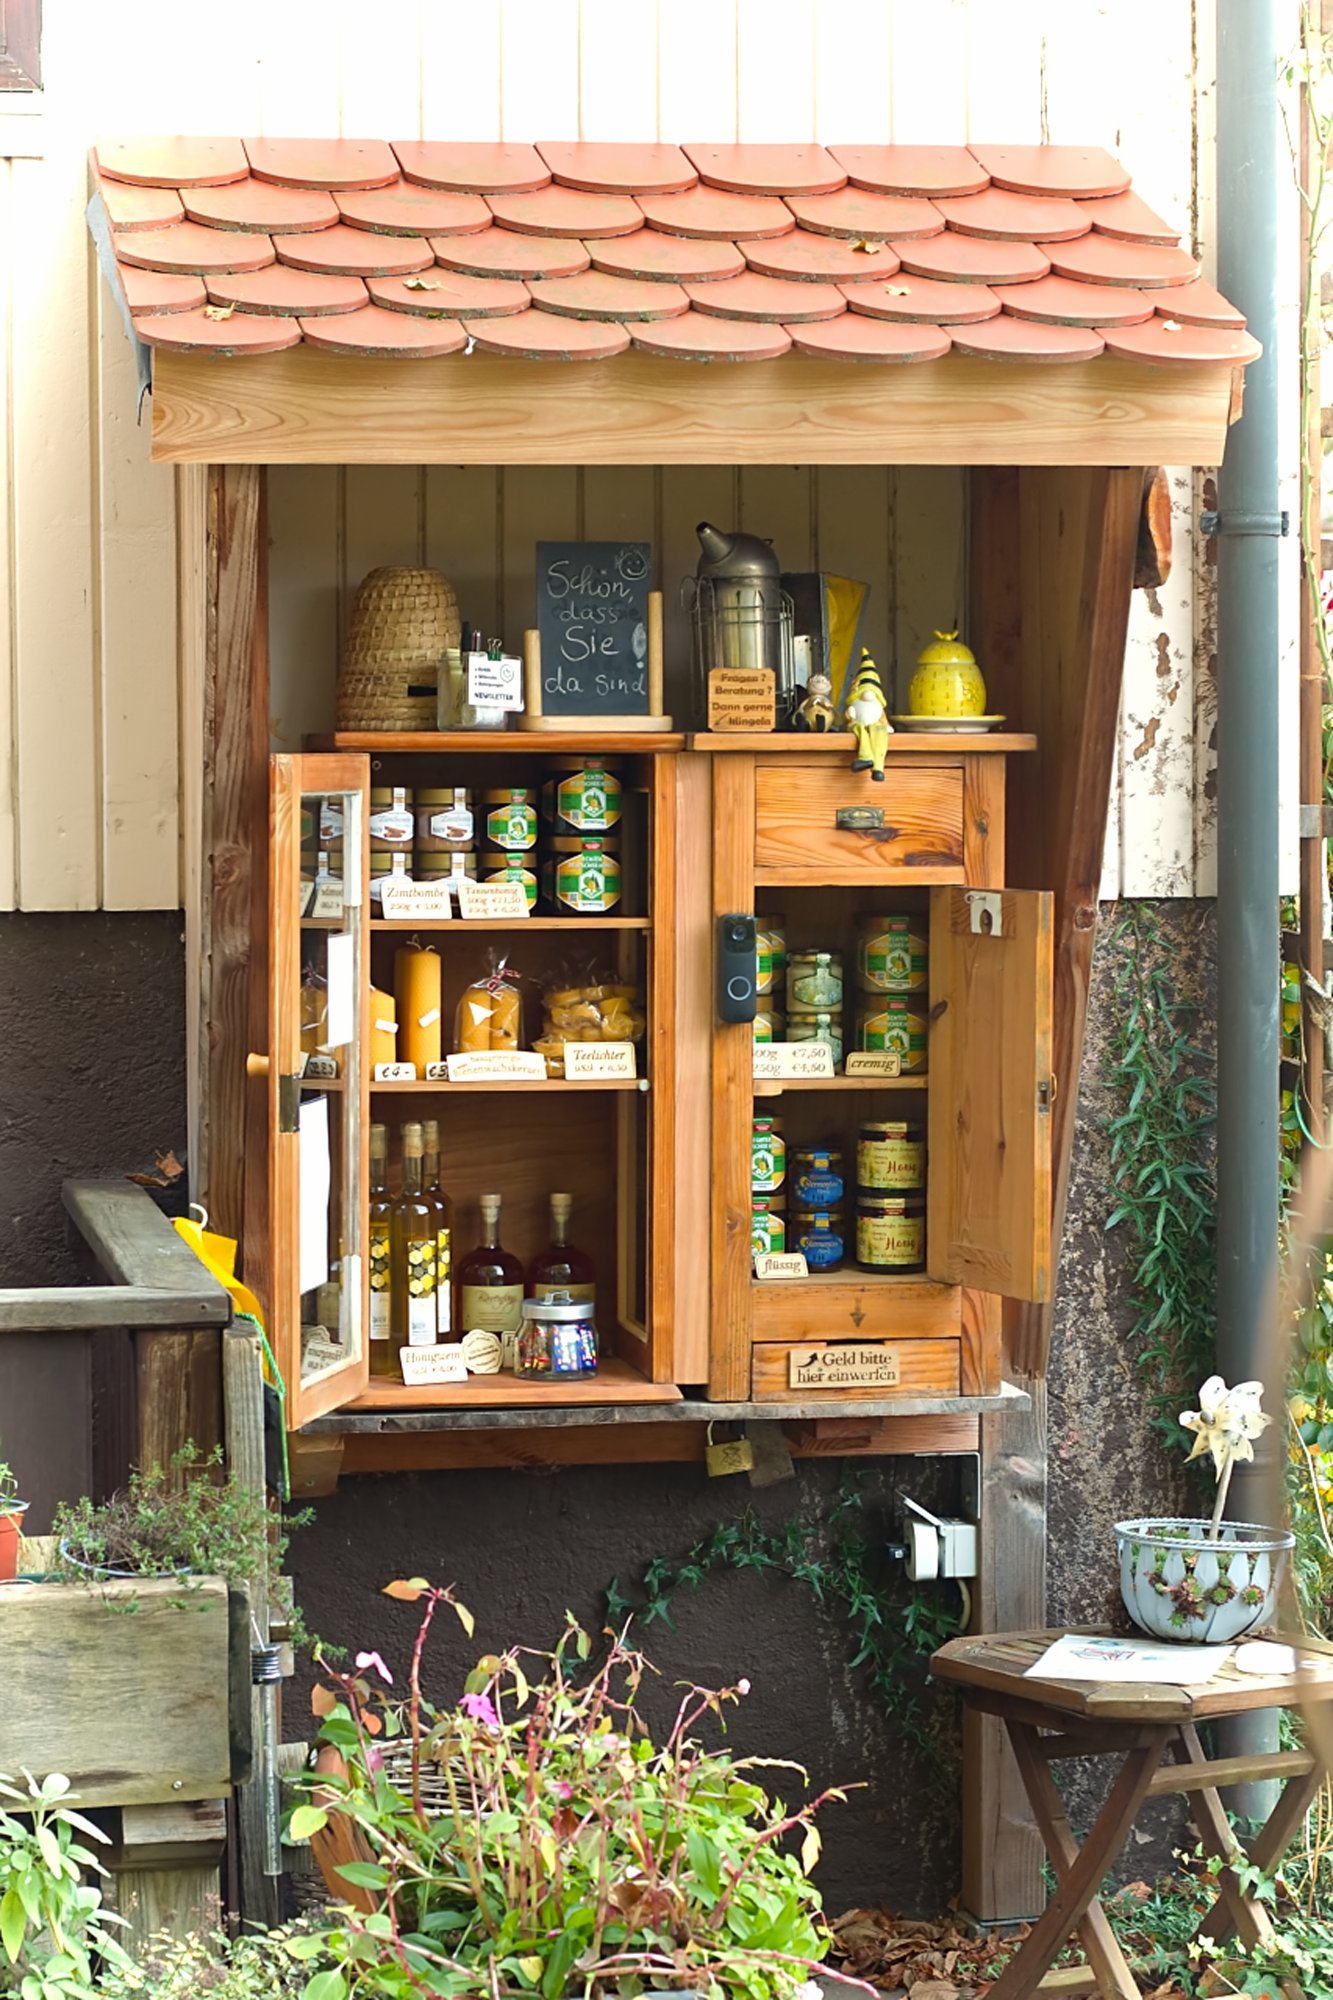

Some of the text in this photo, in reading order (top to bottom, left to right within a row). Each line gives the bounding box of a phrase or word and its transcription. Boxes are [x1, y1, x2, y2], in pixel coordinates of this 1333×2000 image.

[547, 560, 634, 604] Schön,
[559, 601, 619, 624] dass
[561, 625, 620, 662] Sie
[544, 666, 584, 694] da
[721, 673, 759, 684] Fragen
[474, 692, 514, 701] NEWSLETTER
[715, 686, 765, 696] Beratung
[711, 702, 773, 712] Dann gerne
[386, 887, 446, 898] Zimtbombe
[573, 1049, 626, 1060] Teelichter
[792, 1048, 826, 1059] €7,50
[851, 1056, 896, 1072] cremig
[762, 1259, 801, 1274] flüssig
[405, 1352, 460, 1364] Honigwein
[821, 1351, 892, 1366] Geld bitte
[797, 1368, 896, 1383] hier einwerfen
